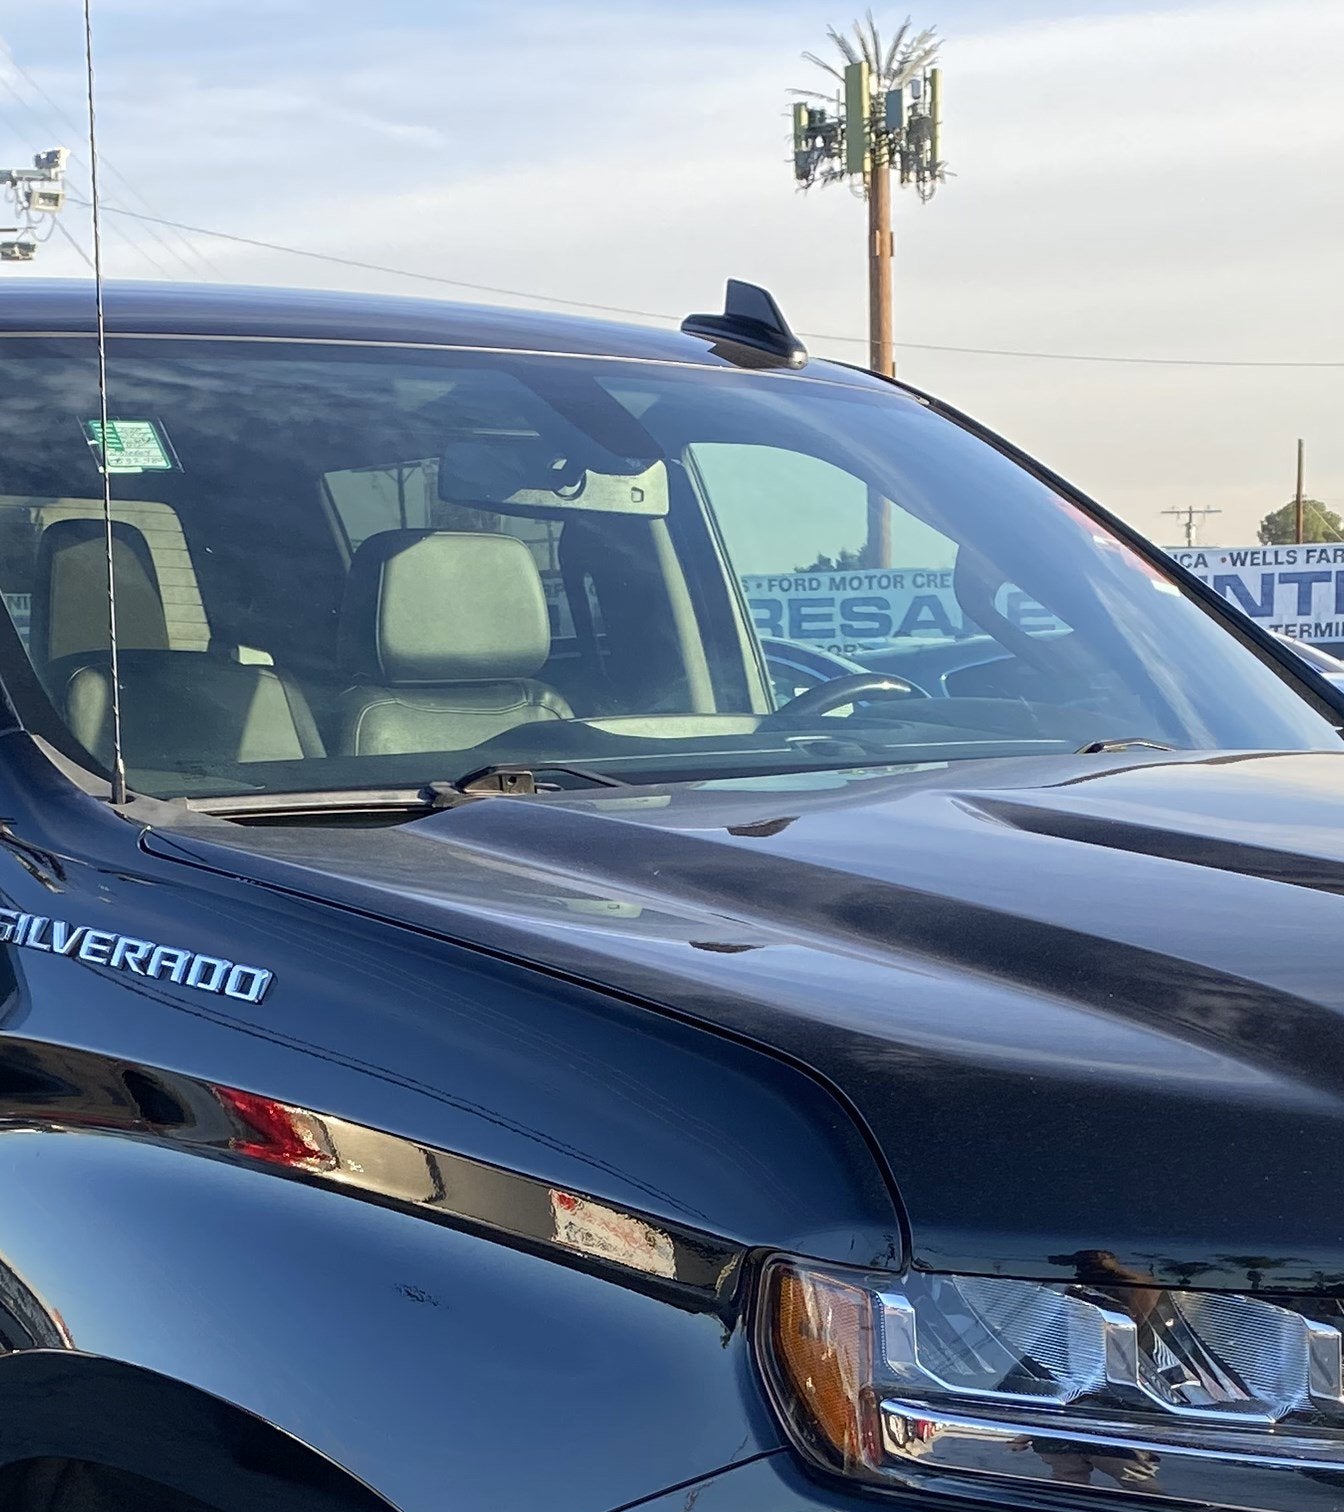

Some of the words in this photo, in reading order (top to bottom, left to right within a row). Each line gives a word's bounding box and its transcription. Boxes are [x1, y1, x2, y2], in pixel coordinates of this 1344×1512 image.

[1229, 549, 1298, 568] WELLS
[767, 577, 821, 592] FORD
[829, 574, 905, 592] MOTOR
[913, 572, 953, 589] CRE
